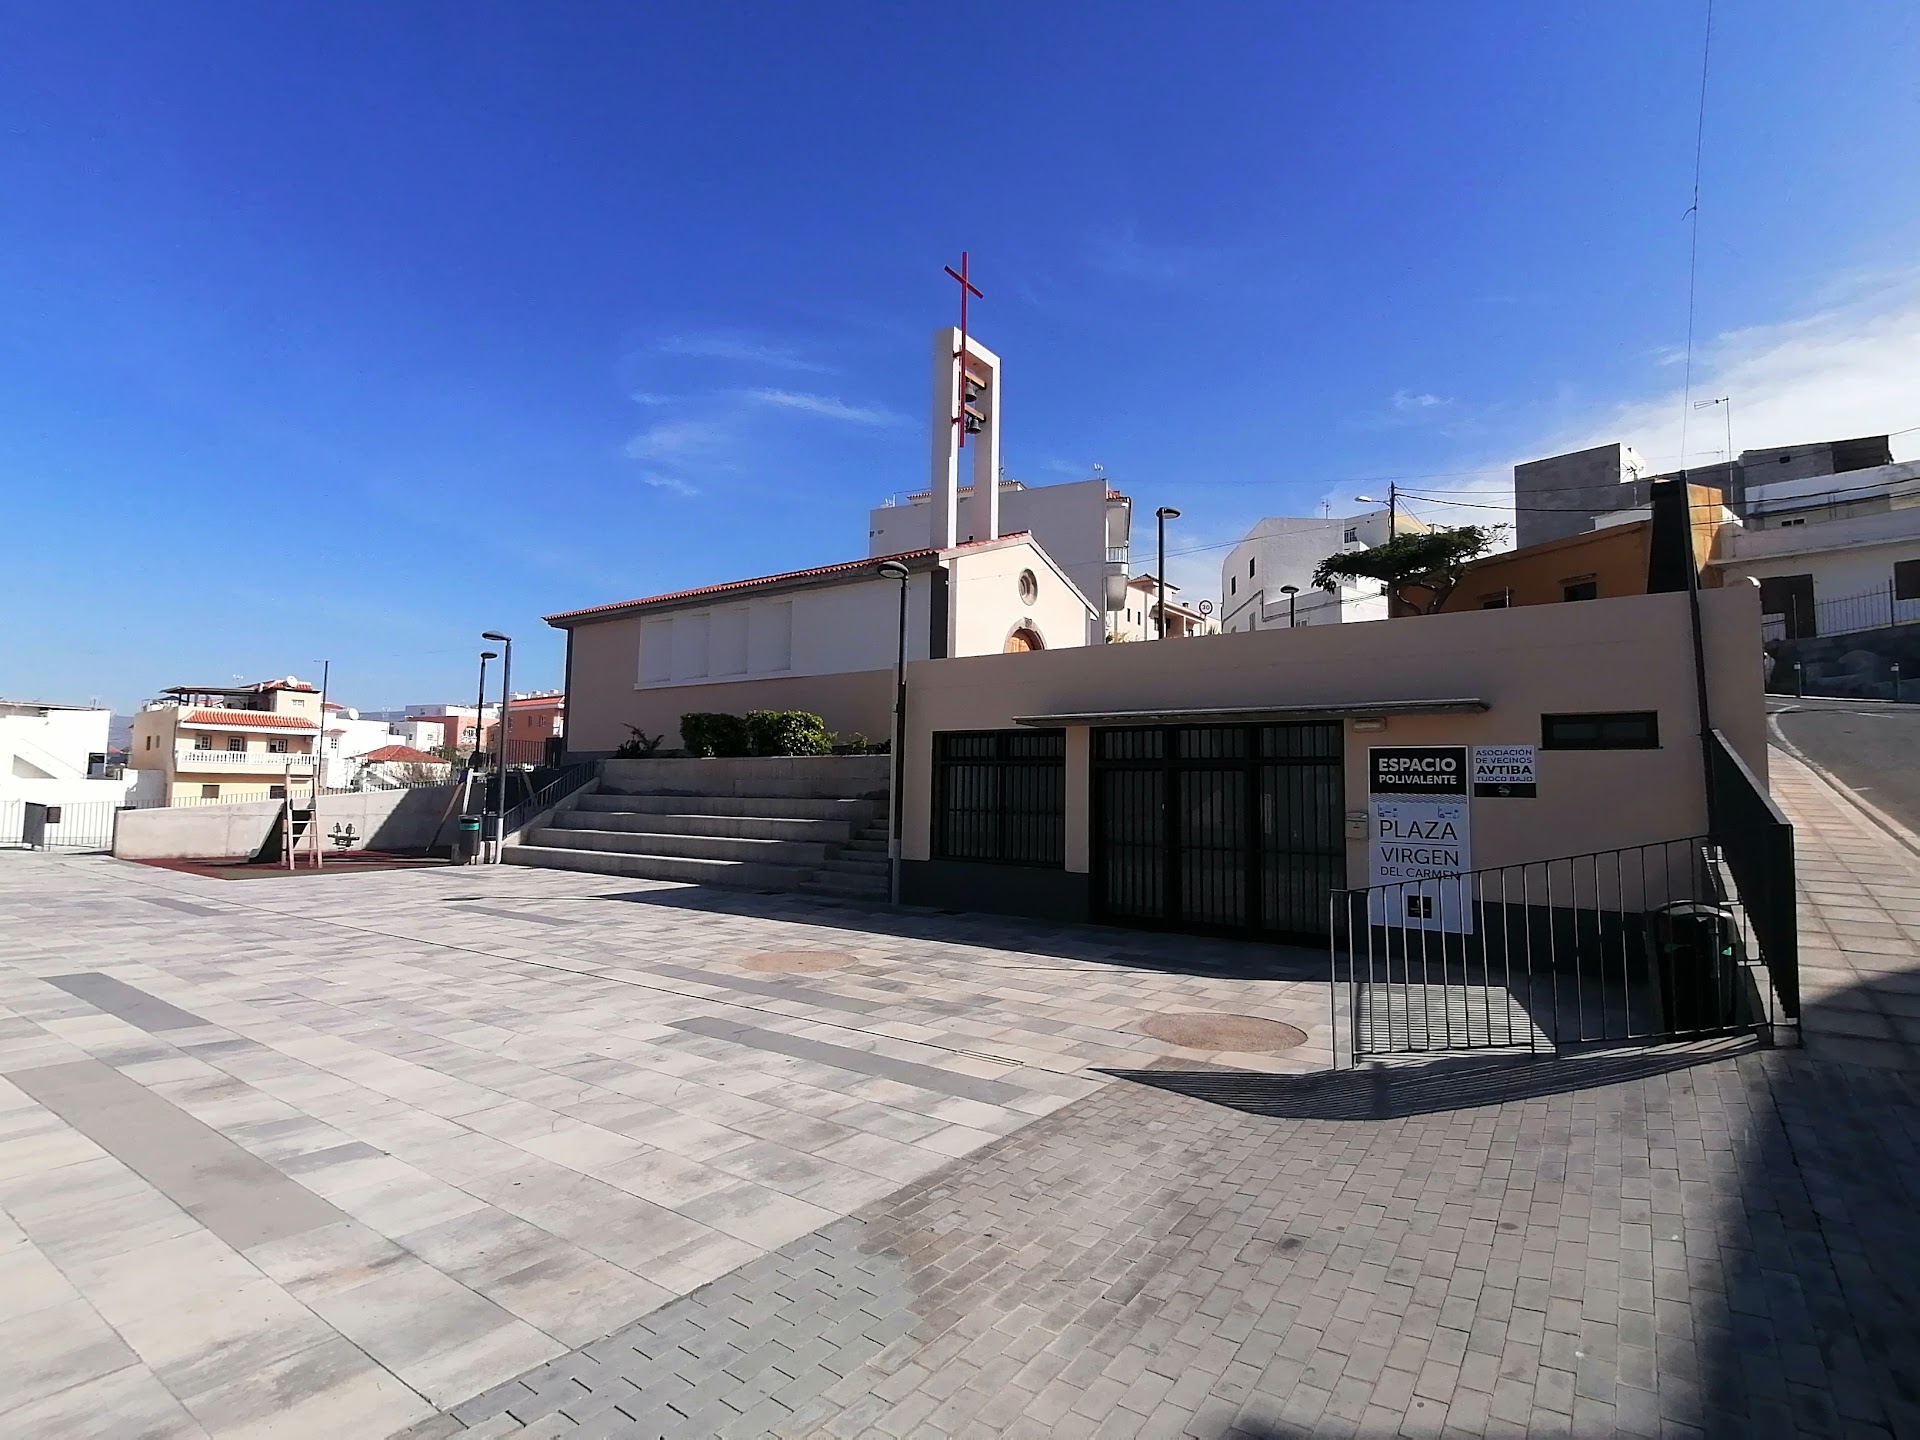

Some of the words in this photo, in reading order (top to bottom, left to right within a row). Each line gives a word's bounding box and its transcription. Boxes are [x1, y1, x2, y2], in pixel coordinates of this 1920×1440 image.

[1476, 748, 1532, 756] ASOCIACIÓN
[1378, 758, 1456, 772] ESPACIO
[1476, 765, 1533, 775] AVTIBA
[1379, 774, 1457, 785] POLIVALENTE
[1380, 820, 1458, 840] PLAZA
[1381, 846, 1459, 867] VIRGEN
[1381, 866, 1403, 877] DEL
[1406, 868, 1459, 881] CARMEN
